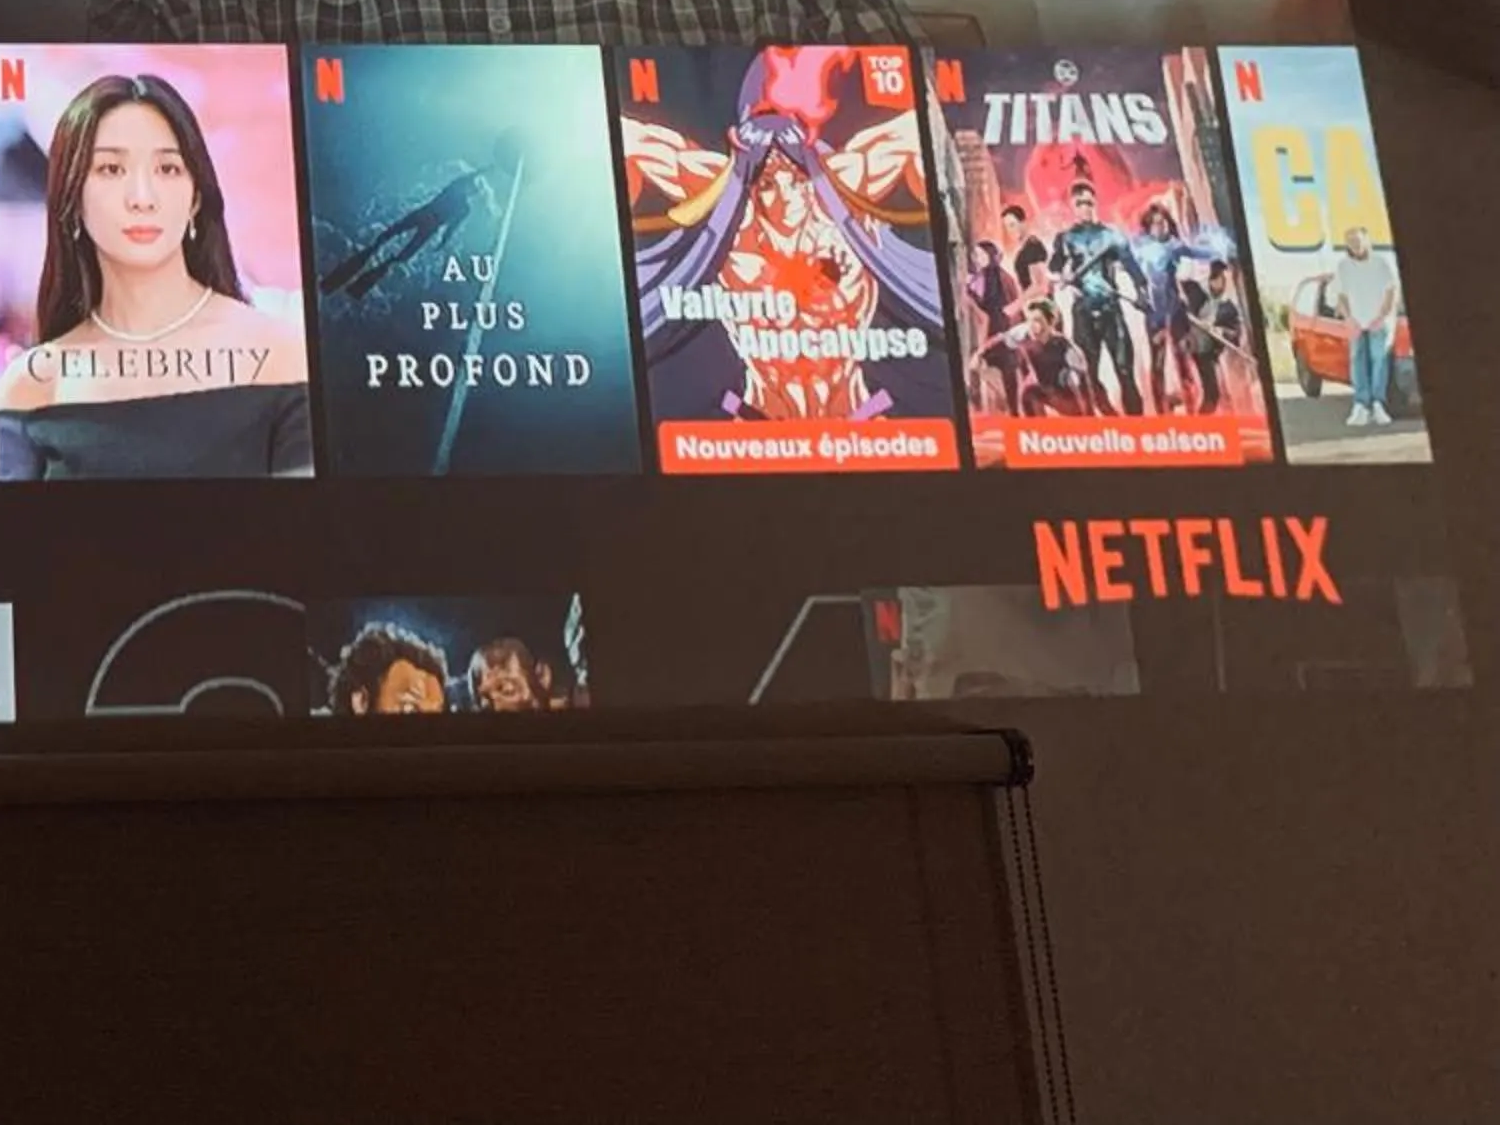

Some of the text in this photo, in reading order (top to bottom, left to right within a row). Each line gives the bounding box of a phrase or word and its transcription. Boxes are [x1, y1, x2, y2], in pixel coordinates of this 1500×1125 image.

[0, 58, 26, 102] N
[315, 58, 345, 104] N
[629, 59, 660, 103] N
[867, 55, 903, 72] TOP
[872, 70, 904, 95] 10
[936, 59, 965, 103] N
[1234, 61, 1263, 102] N
[984, 92, 1168, 146] TITANS
[442, 255, 493, 282] AU
[421, 302, 526, 331] PLUS
[659, 283, 797, 325] Valkyrie
[737, 323, 929, 361] Apocalypse
[27, 346, 270, 386] CELEBRITY
[366, 353, 593, 388] PROFOND
[675, 428, 938, 464] Nouveaux épisodes
[1019, 429, 1226, 455] Nouvelle saison
[1033, 516, 1343, 611] NETFLIX
